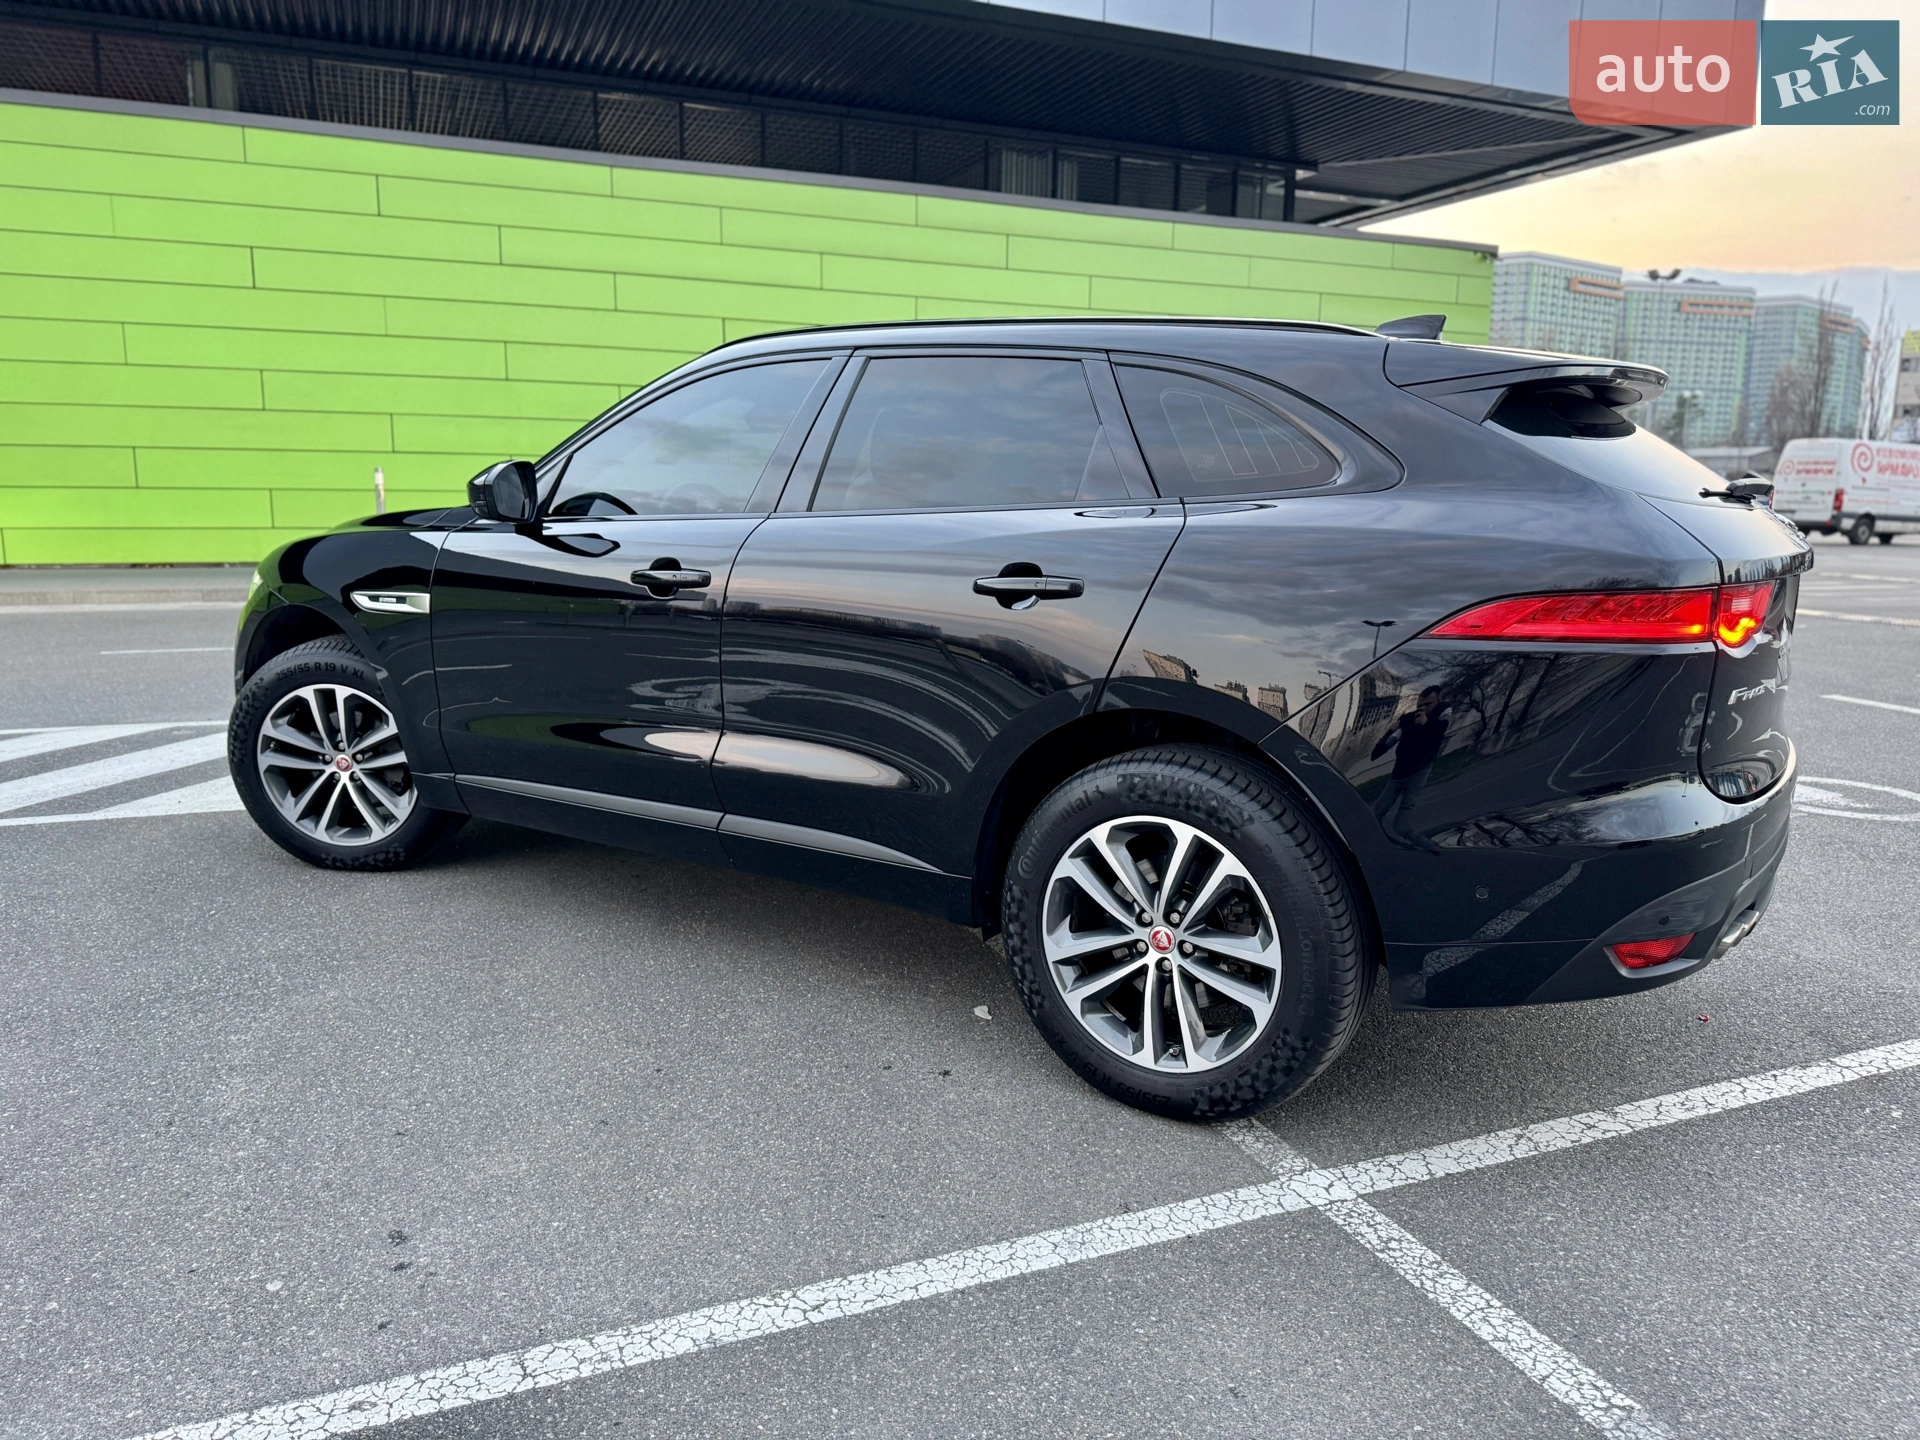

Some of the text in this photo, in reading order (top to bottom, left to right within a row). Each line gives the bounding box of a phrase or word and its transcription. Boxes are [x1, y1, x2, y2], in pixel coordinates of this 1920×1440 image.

[275, 661, 365, 682] 255/55 R 19 V XL
[1017, 788, 1094, 880] Continental
